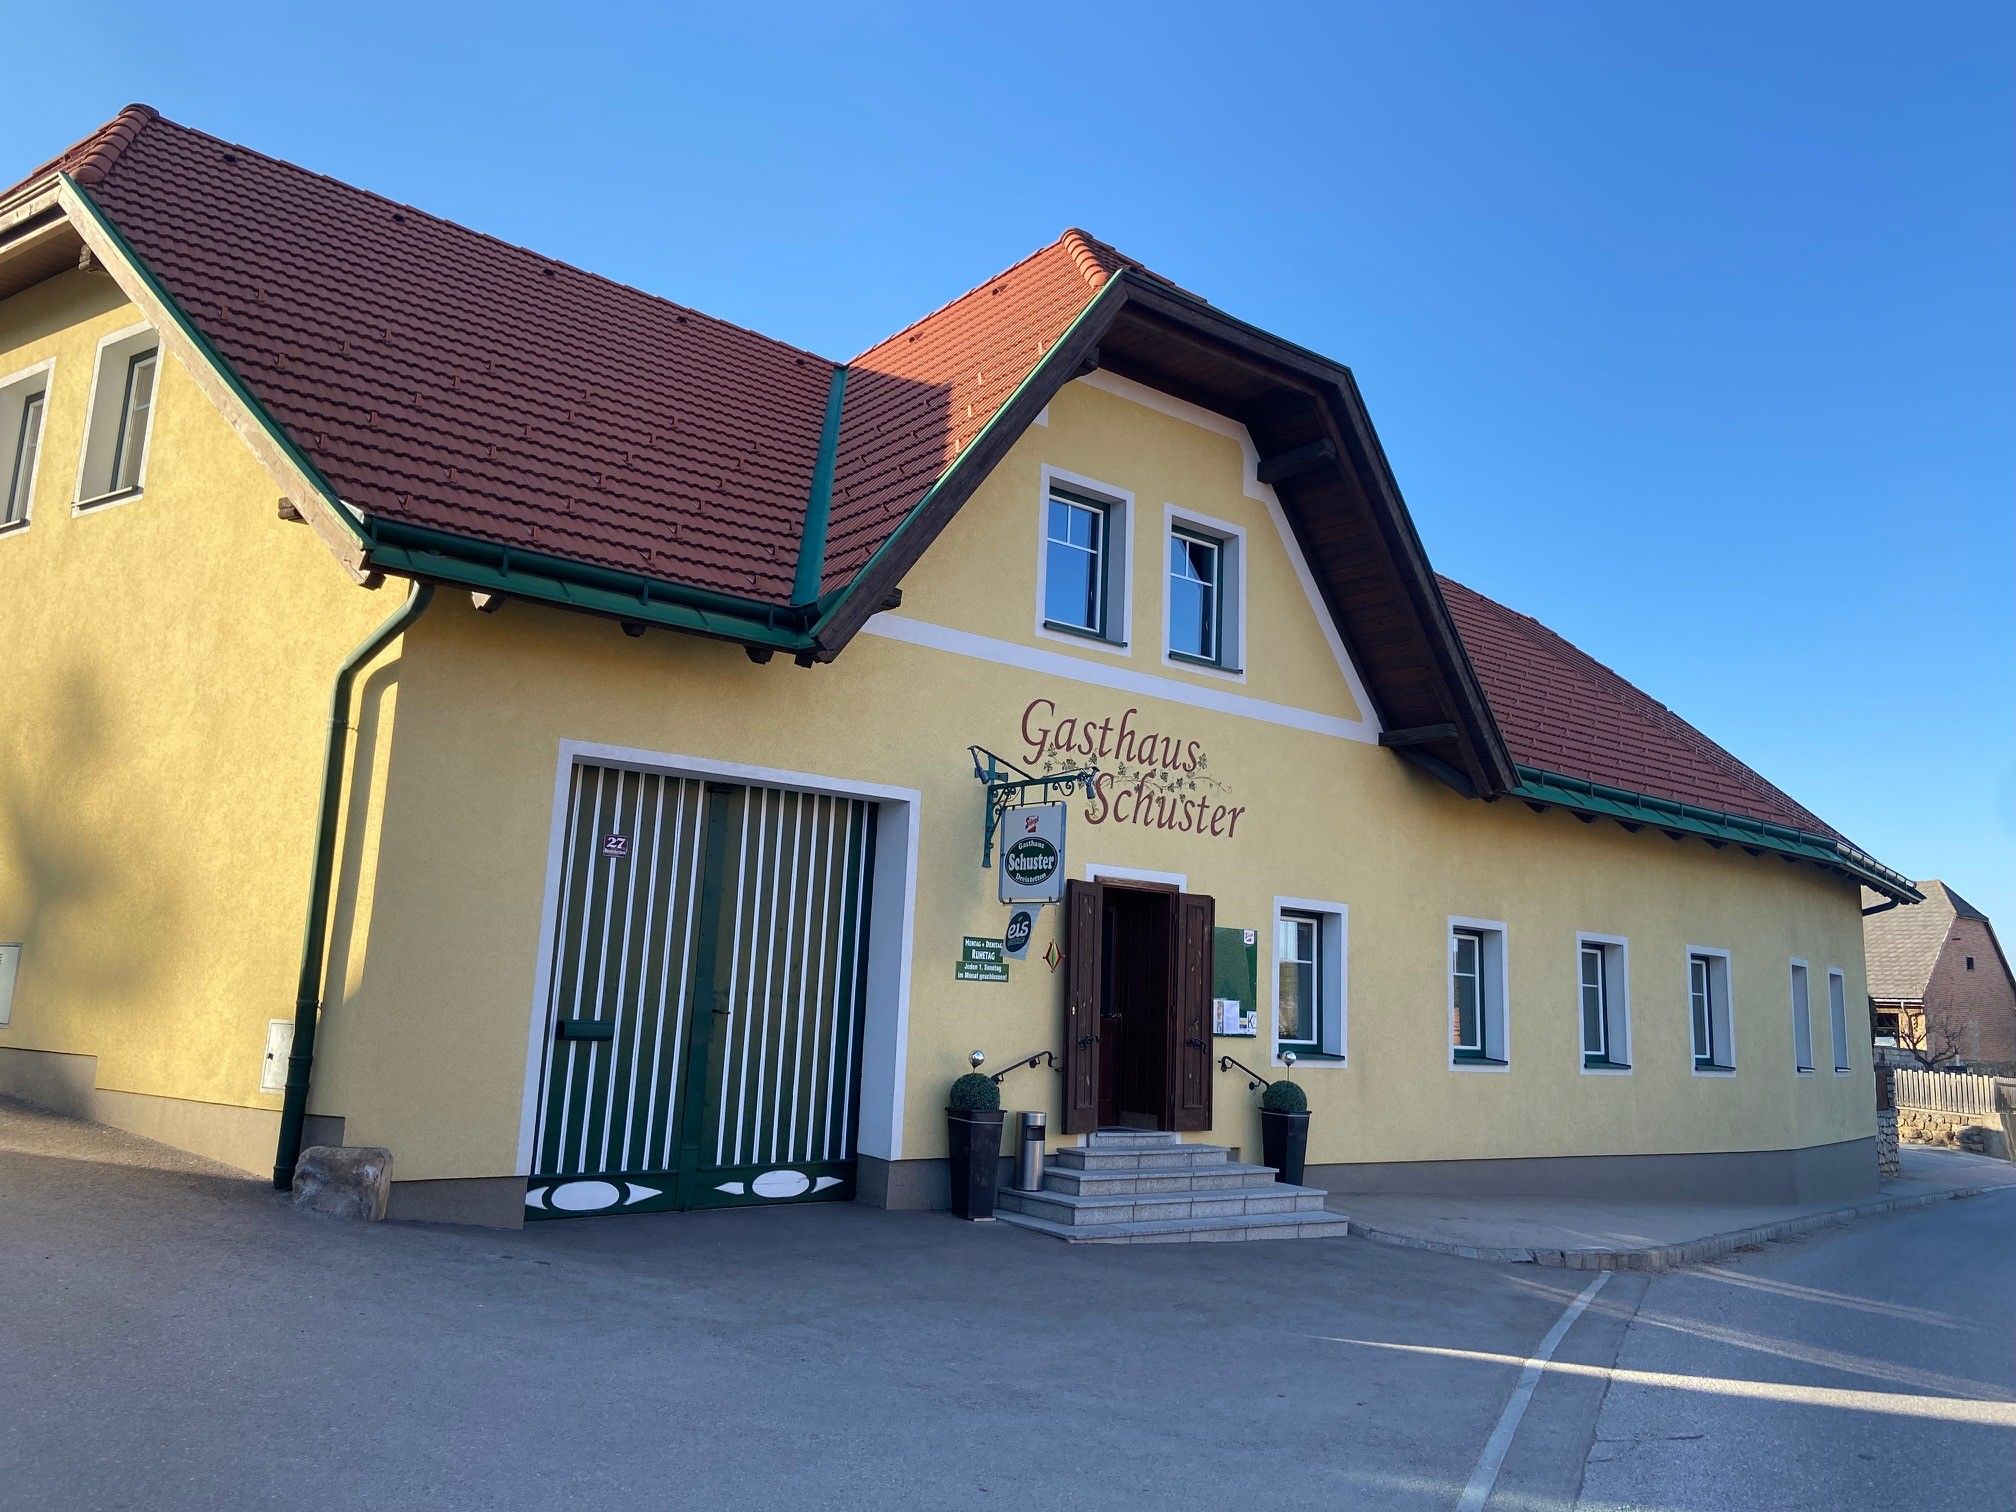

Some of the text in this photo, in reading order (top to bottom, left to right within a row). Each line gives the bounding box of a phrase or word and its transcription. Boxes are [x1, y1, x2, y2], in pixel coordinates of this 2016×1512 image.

[1021, 698, 1200, 772] Gasthaus
[1084, 772, 1246, 838] Schuster
[606, 837, 626, 848] 27
[1018, 840, 1045, 849] Gasthaus
[1008, 852, 1055, 872] Schuster
[971, 949, 996, 960] RUHETAG
